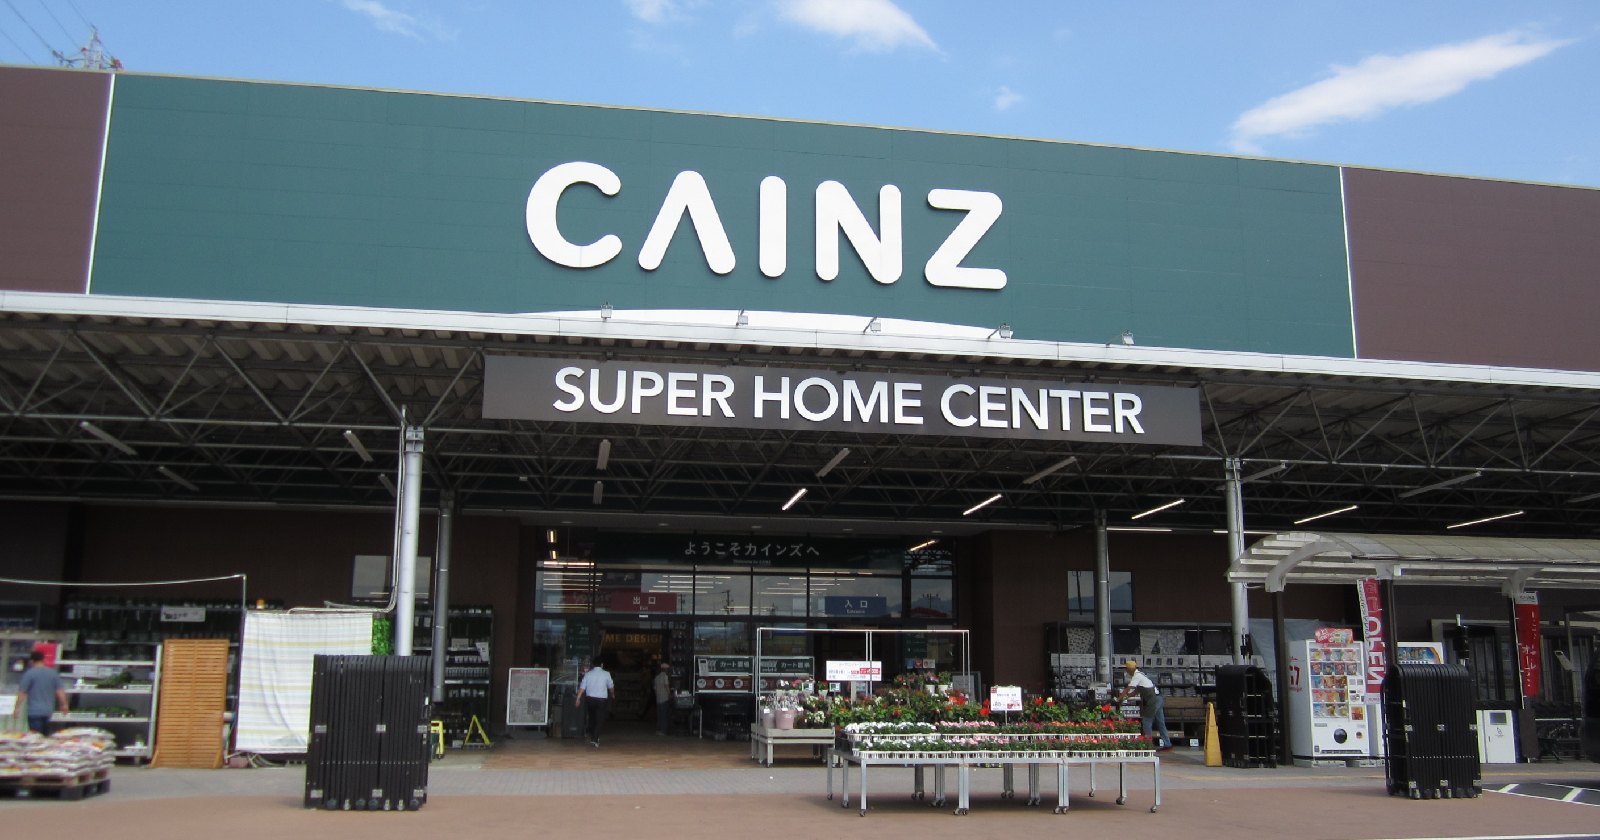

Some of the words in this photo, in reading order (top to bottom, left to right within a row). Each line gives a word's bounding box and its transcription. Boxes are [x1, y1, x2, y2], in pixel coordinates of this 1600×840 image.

[526, 161, 1008, 290] CAINZ
[553, 366, 735, 418] SUPER
[754, 375, 924, 425] HOME
[940, 383, 1145, 434] CENTER
[684, 541, 820, 556] ようこそカインズへ
[632, 596, 656, 605] 出口
[844, 600, 868, 608] 入口
[605, 633, 621, 643] ME
